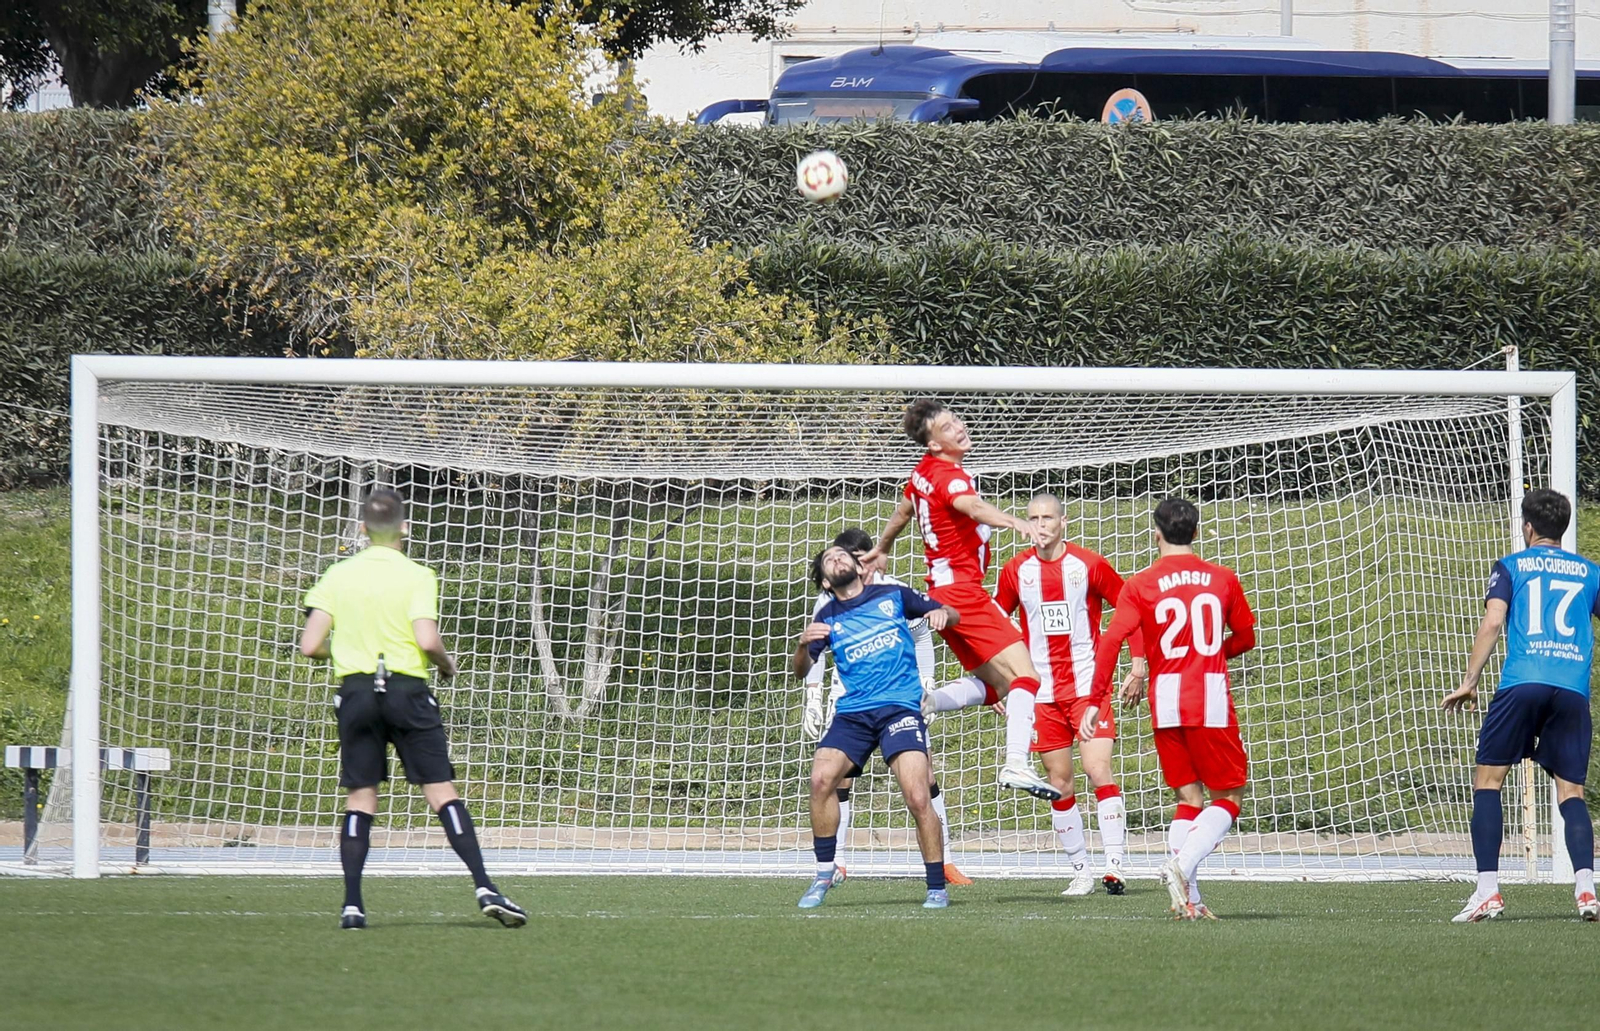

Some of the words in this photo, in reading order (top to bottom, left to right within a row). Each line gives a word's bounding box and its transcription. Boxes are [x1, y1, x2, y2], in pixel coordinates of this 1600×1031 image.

[1517, 556, 1544, 572] PABLO
[1544, 557, 1588, 578] GUERRERO
[1157, 570, 1212, 593] MARSU
[1048, 608, 1063, 617] DA
[1526, 576, 1585, 637] 17
[1049, 618, 1065, 628] ZN
[1154, 592, 1223, 660] 20
